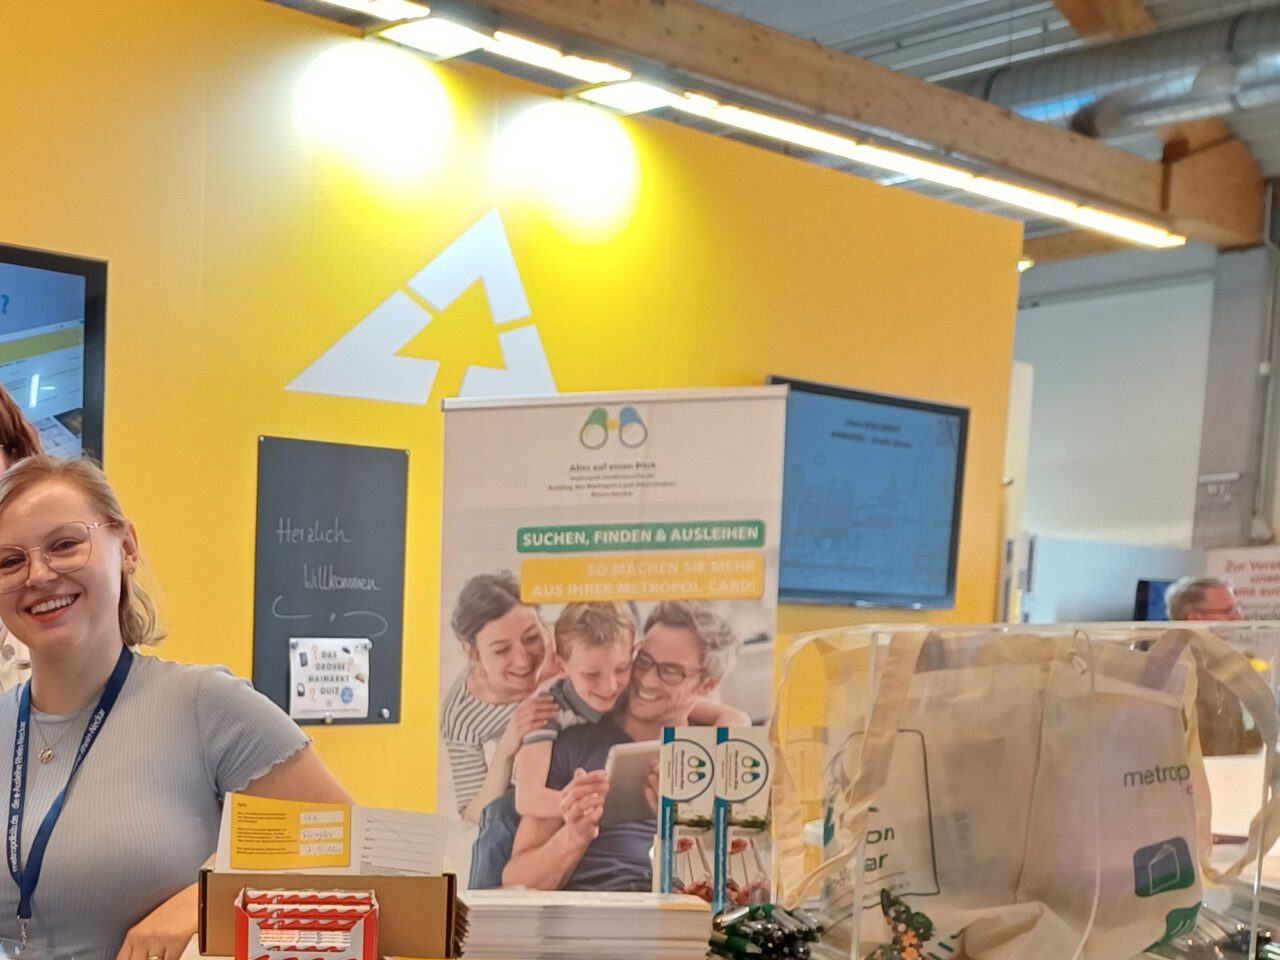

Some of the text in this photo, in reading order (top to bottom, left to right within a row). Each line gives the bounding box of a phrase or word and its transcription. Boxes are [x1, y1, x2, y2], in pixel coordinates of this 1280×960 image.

[276, 516, 351, 544] Herzlich
[523, 526, 758, 546] SUCHEN, FINDEN & AUSLEIHEN
[303, 563, 382, 591] Willkommen
[321, 650, 337, 659] DAS
